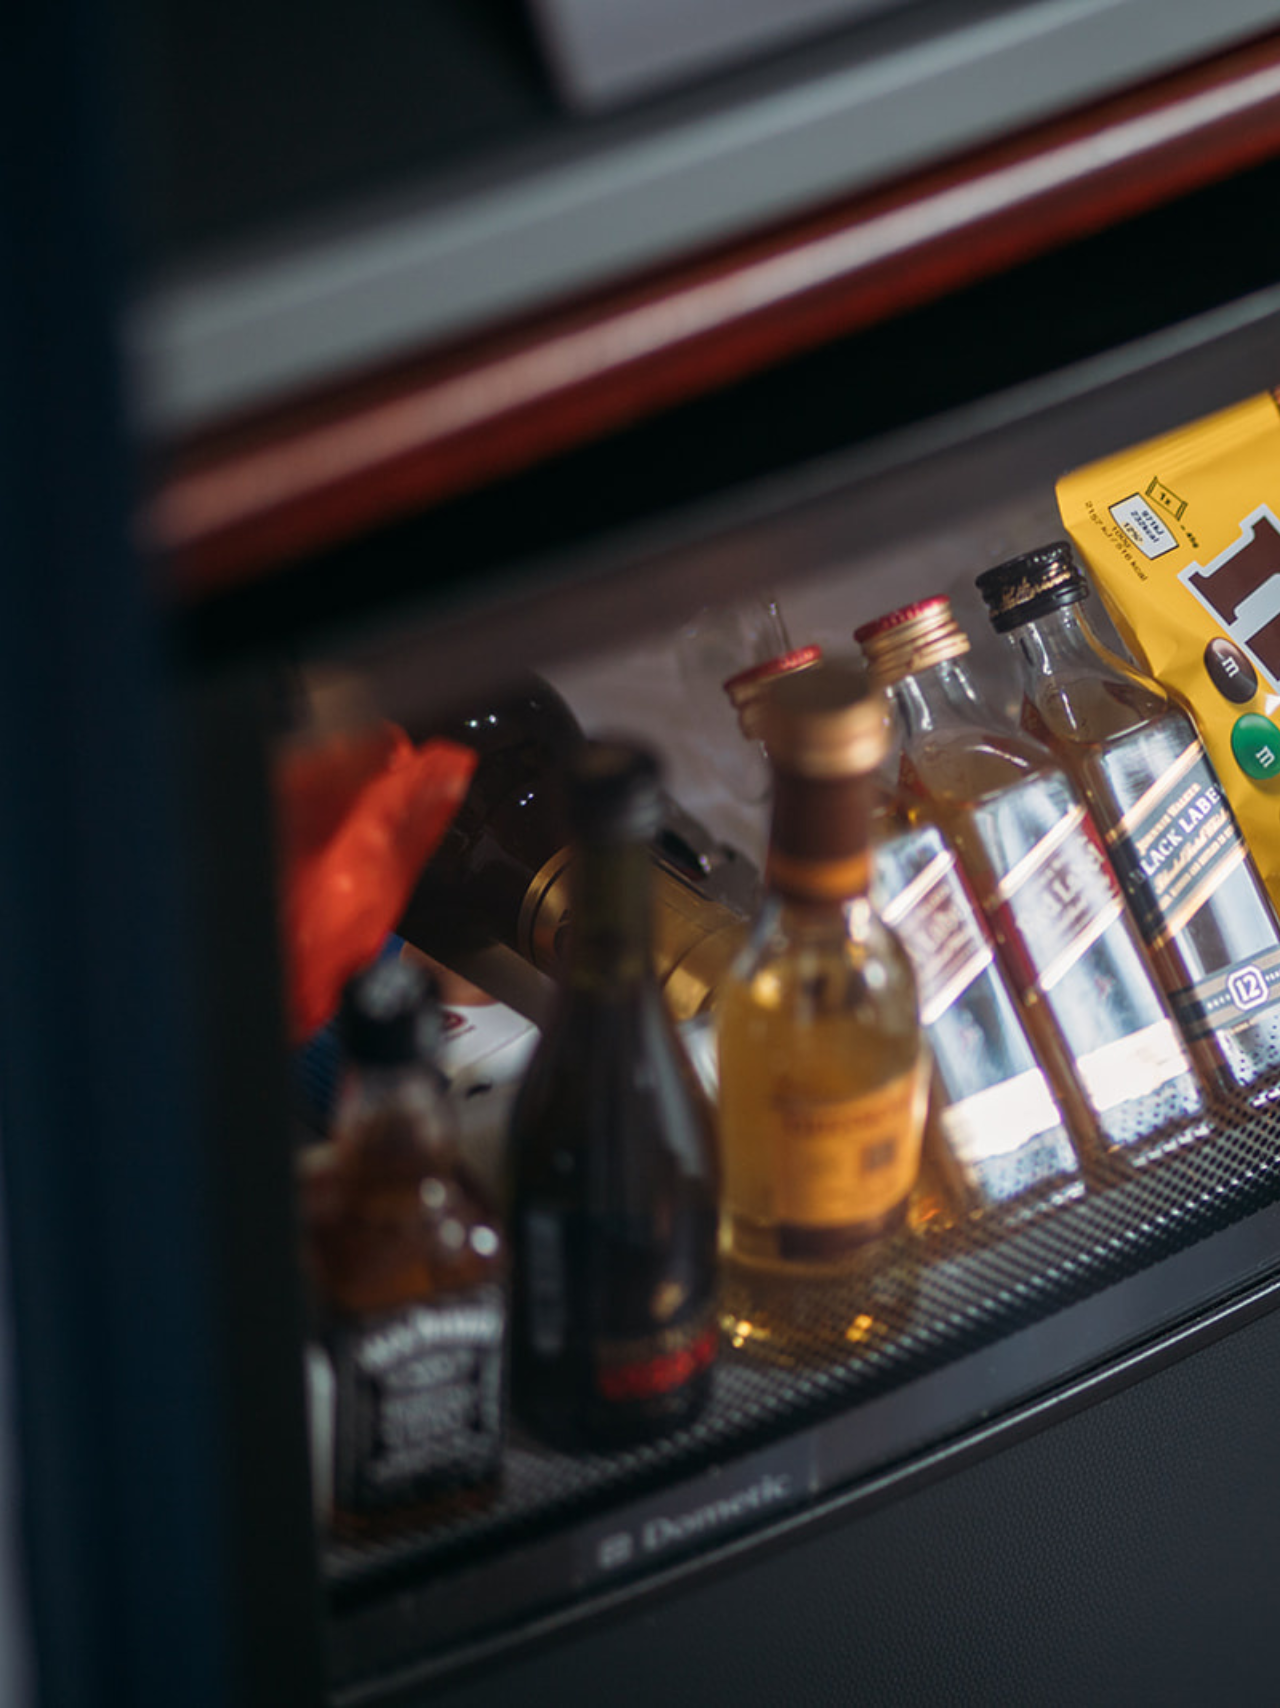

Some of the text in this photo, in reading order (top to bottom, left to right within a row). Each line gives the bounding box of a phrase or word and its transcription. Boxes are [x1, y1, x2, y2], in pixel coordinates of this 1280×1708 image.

[1221, 656, 1241, 679] m
[1254, 745, 1276, 769] m
[1236, 973, 1261, 1003] 12
